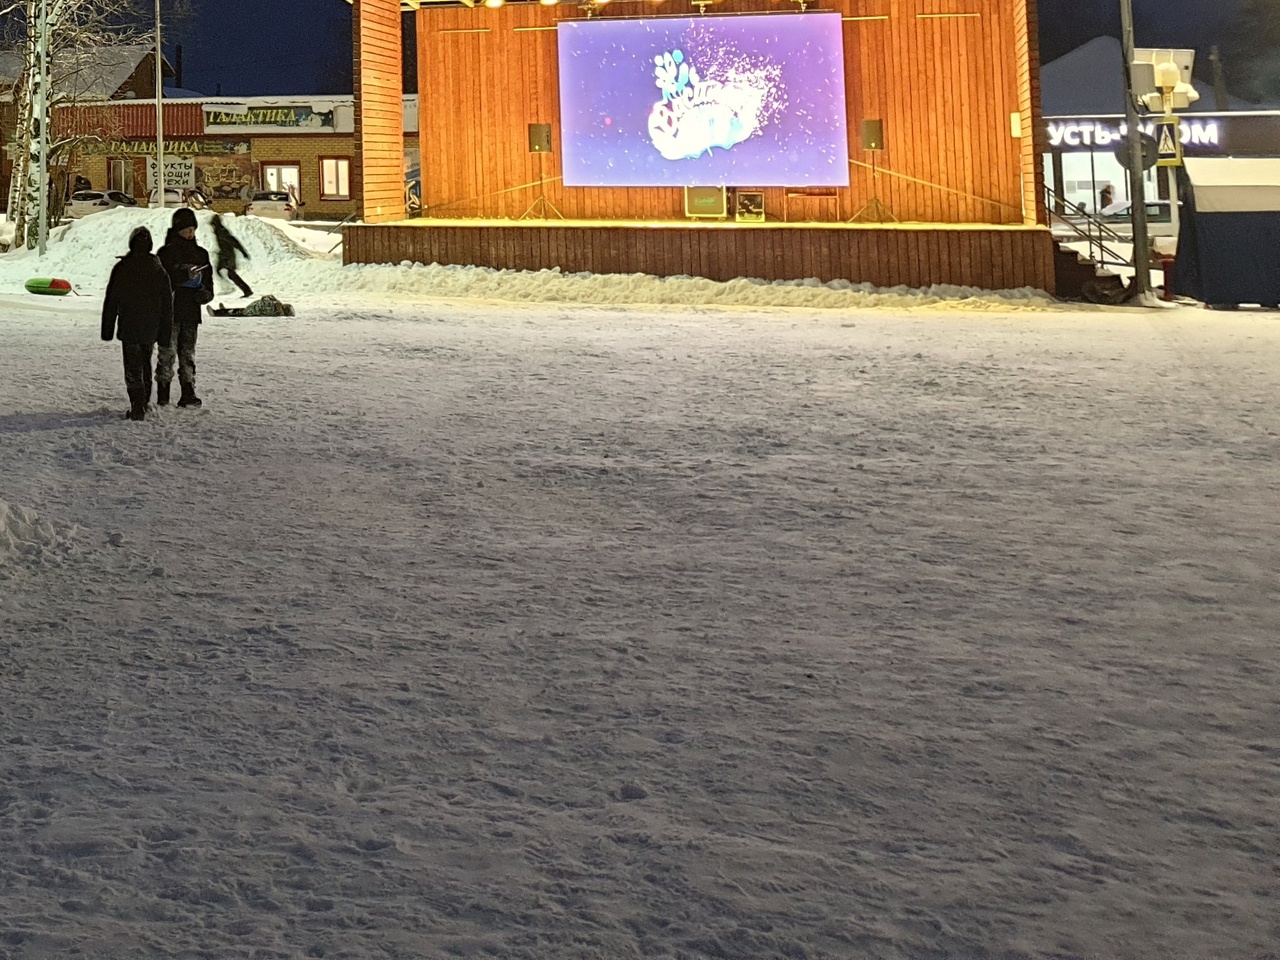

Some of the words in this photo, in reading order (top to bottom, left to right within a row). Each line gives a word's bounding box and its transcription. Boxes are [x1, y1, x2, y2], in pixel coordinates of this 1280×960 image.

[209, 109, 296, 122] ГАЛАКТИКА
[111, 141, 199, 153] ГАЛАКТИКА
[150, 162, 193, 170] ФУКТЫ
